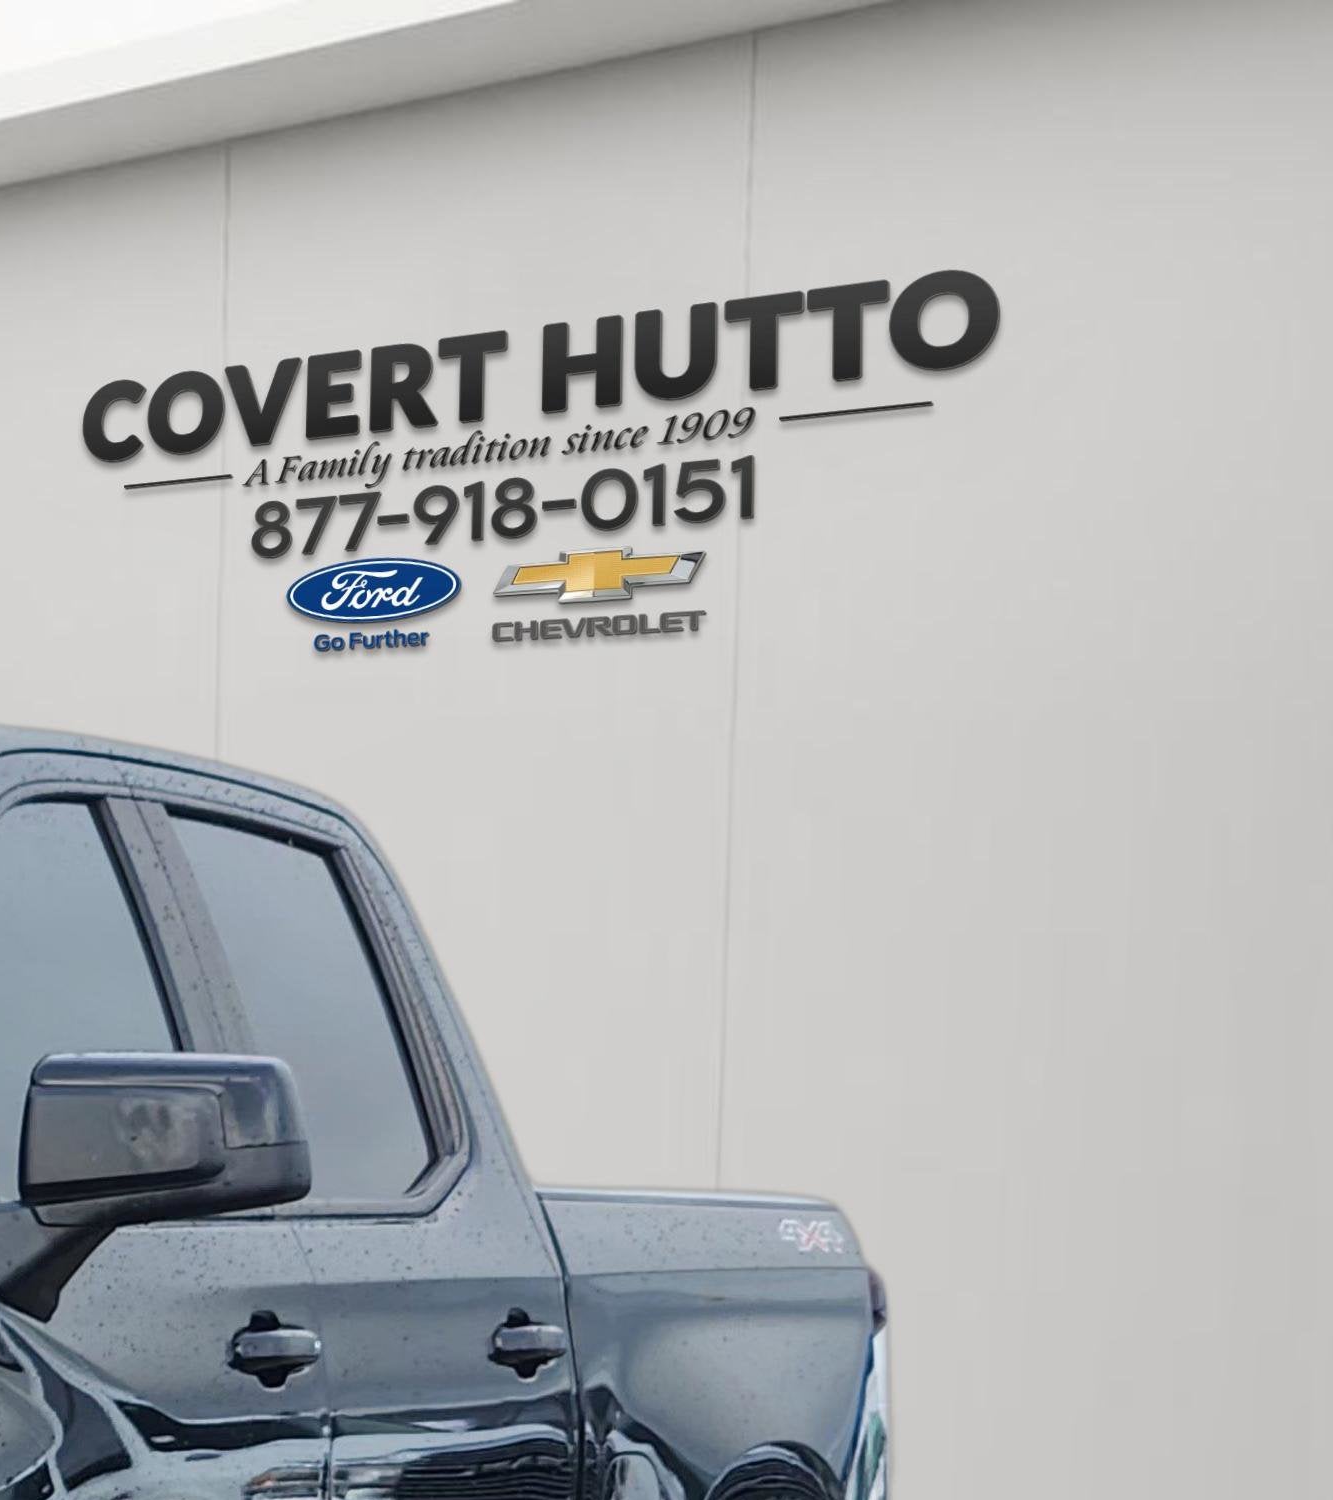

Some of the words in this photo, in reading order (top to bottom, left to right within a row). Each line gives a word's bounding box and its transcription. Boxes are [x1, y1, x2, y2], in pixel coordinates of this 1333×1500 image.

[81, 330, 509, 464] COVERT
[540, 269, 1001, 414] HUTTO
[242, 458, 270, 488] A
[274, 441, 393, 489] Family
[402, 429, 551, 473] tradition
[561, 422, 649, 456] since
[656, 405, 757, 447] 1909
[249, 454, 756, 560] 877-918-0151
[319, 568, 424, 612] Ford
[313, 633, 345, 653] Go
[348, 629, 431, 651] Further
[491, 609, 708, 643] CHEVROLET
